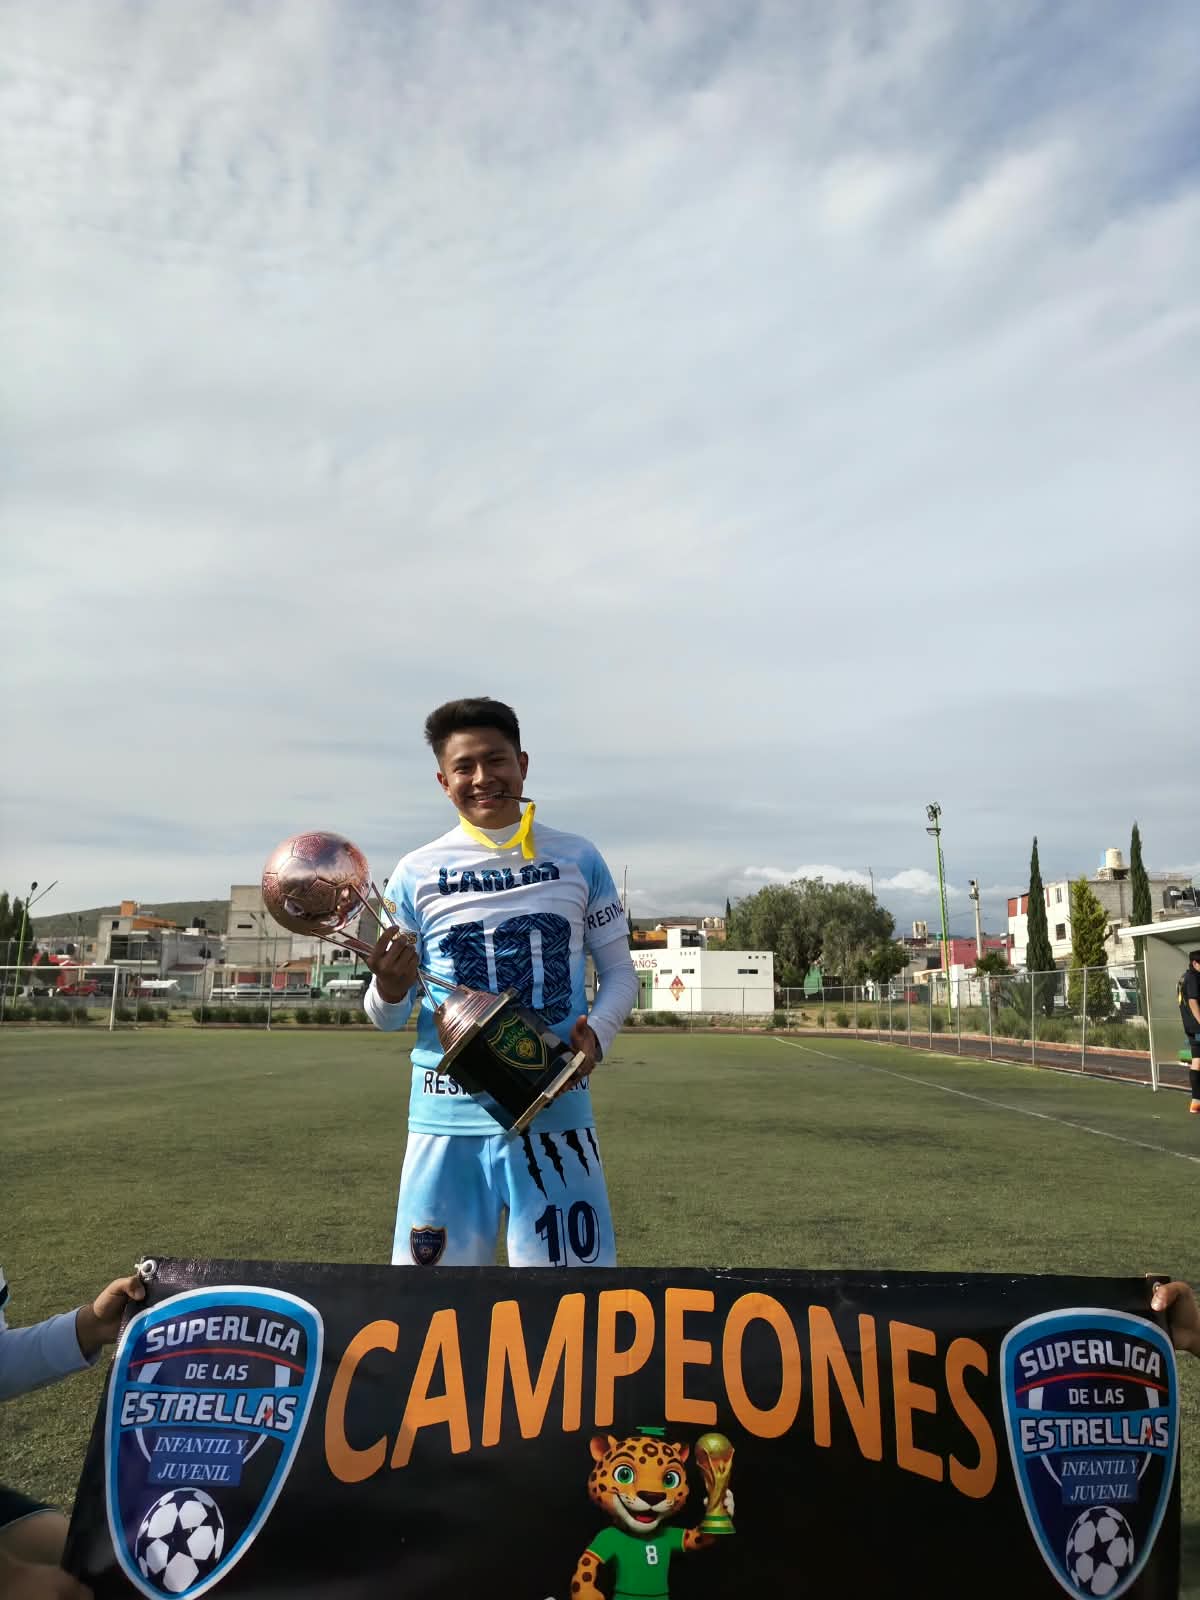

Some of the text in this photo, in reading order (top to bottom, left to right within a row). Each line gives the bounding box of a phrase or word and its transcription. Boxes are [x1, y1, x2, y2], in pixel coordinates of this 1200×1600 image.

[438, 912, 572, 1026] 10
[632, 957, 658, 969] AÑOS
[534, 1201, 600, 1268] 10
[145, 1316, 301, 1357] SUPERLIGA
[1019, 1339, 1161, 1378] SUPERLIGA
[185, 1363, 249, 1381] DE LAS
[324, 1287, 998, 1500] CAMPEONES
[1068, 1388, 1124, 1405] DE LAS
[120, 1391, 298, 1432] ESTRELLAS
[1019, 1416, 1169, 1453] ESTRELLAS
[154, 1436, 250, 1455] INFANTIL Y
[157, 1462, 232, 1482] JUVENIL
[1062, 1459, 1140, 1477] INFANTIL Y
[1070, 1484, 1131, 1501] JUVENIL
[645, 1545, 658, 1565] 8
